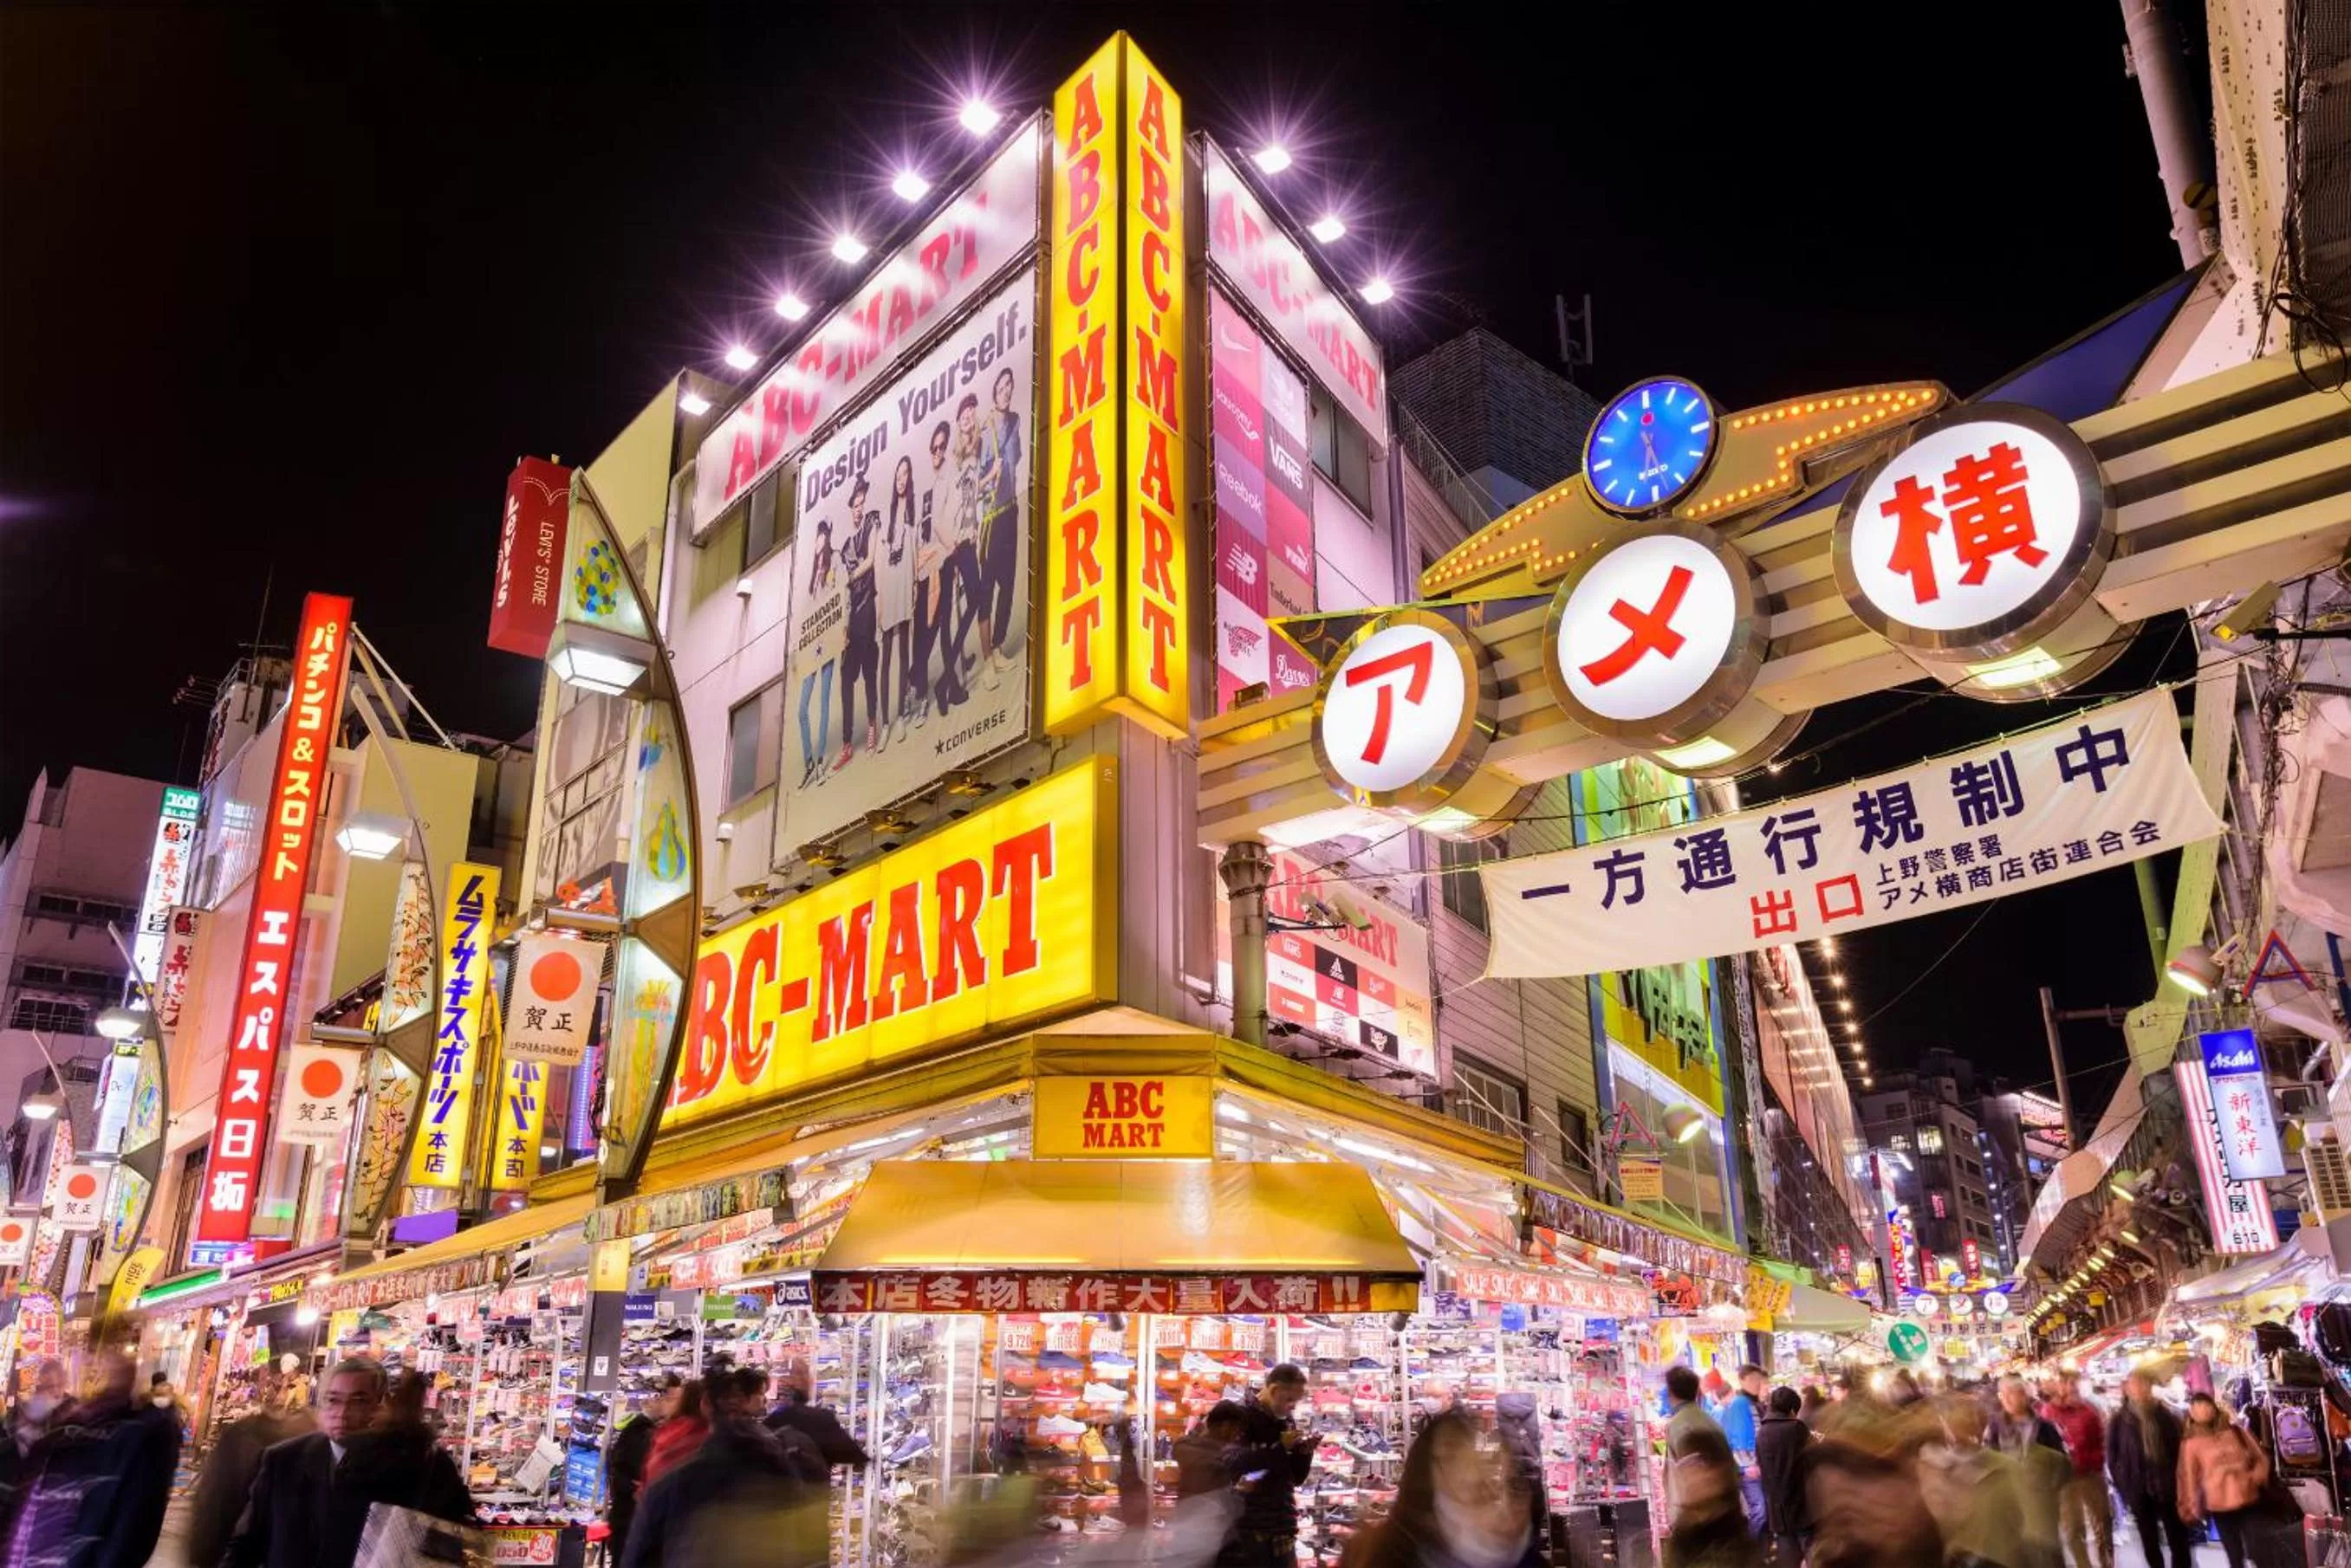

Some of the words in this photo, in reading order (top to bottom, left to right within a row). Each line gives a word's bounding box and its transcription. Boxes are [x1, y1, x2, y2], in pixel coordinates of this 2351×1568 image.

[1059, 69, 1107, 691] ABC-MART
[1135, 74, 1179, 693] ABC-MART
[805, 421, 888, 513] Design
[898, 301, 1027, 435] Yourself.
[1270, 436, 1303, 489] VANS
[1218, 463, 1263, 516] Reebok
[532, 565, 549, 607] STORE
[798, 609, 843, 651] COLLECTION
[801, 593, 841, 635] STANDARD
[945, 709, 1006, 753] CONVERSE
[1521, 723, 2129, 910] 一方通行規制中
[1875, 833, 2004, 887] 上野警察署
[1879, 819, 2162, 910] アメ横商店街連合会
[1750, 873, 1865, 939] 出口
[664, 822, 1055, 1107] BC-MART
[428, 875, 485, 1124] ムラサキスポーツ
[523, 1005, 574, 1033] 賀正
[2209, 1049, 2256, 1069] Asahi
[1082, 1080, 1165, 1119] ABC
[425, 1130, 449, 1174] 本店
[1082, 1122, 1165, 1148] MART
